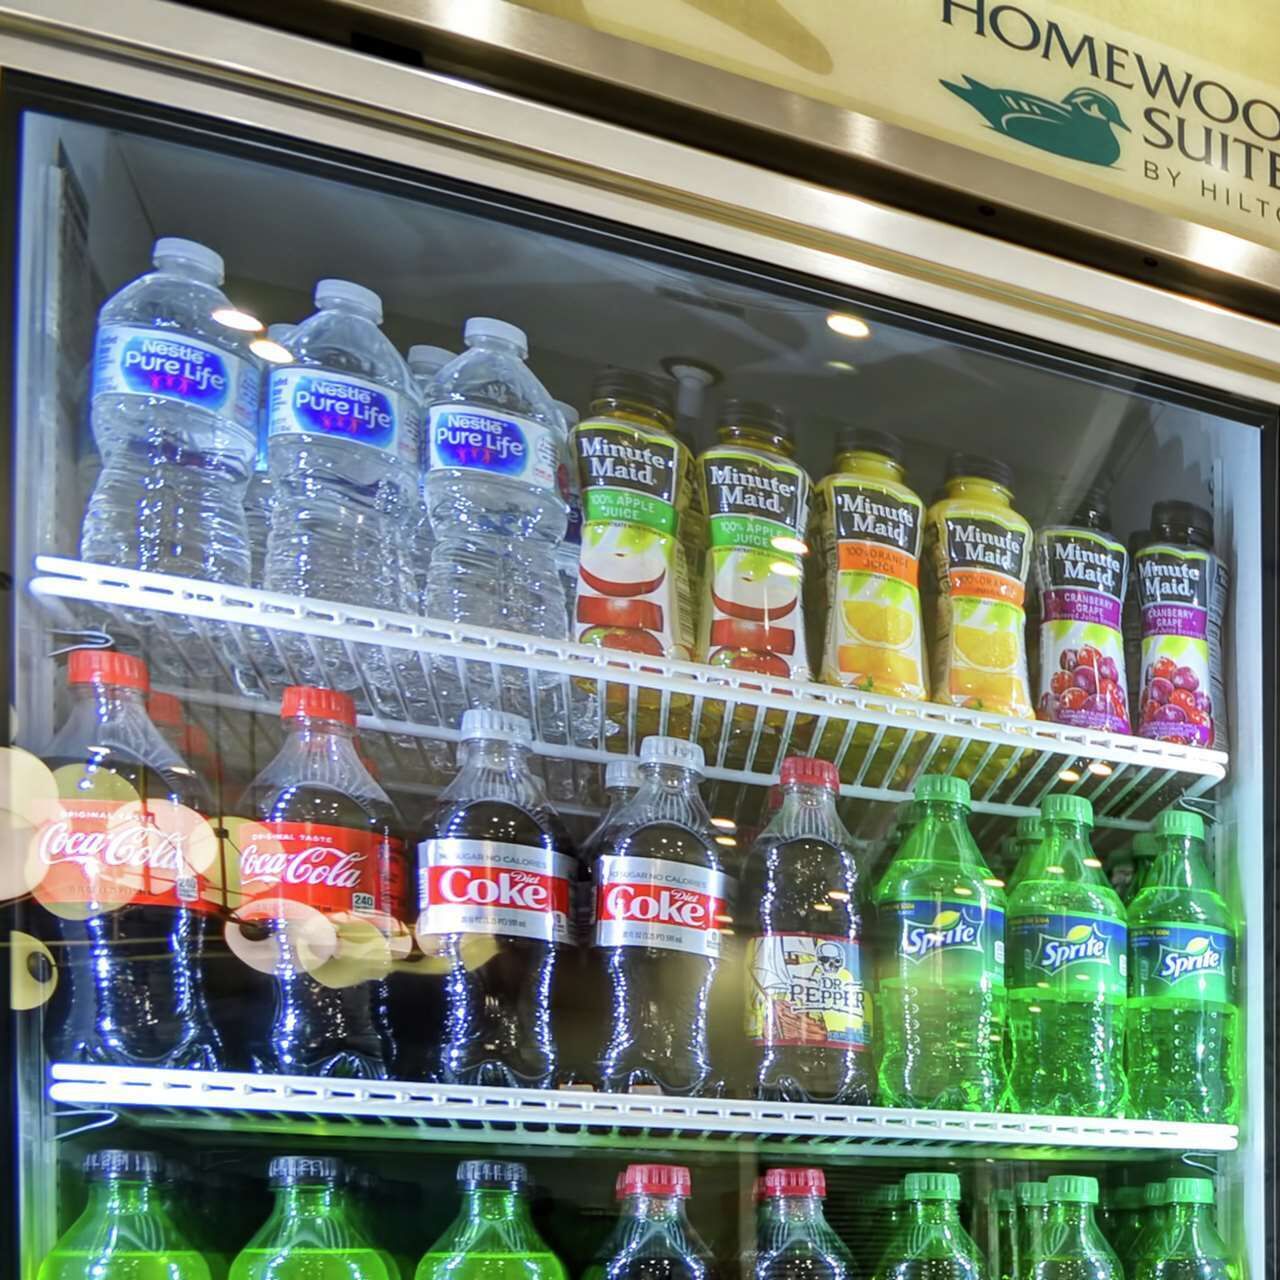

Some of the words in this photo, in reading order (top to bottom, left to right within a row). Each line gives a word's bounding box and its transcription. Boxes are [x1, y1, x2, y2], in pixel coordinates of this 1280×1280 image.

[1144, 160, 1181, 186] BY
[125, 351, 180, 374] Pure
[184, 360, 225, 390] Life
[296, 391, 349, 415] Pure
[353, 402, 392, 428] Life
[437, 427, 482, 447] Pure
[487, 436, 524, 459] Life
[580, 437, 665, 468] Minute
[591, 457, 655, 485] Maid
[710, 465, 792, 496] Minute
[617, 495, 655, 512] APPLE
[720, 486, 782, 513] Maid
[842, 494, 913, 526] Minute
[853, 514, 906, 542] Maid
[954, 525, 1020, 553] Minute
[965, 543, 1013, 570] Maid
[1055, 542, 1120, 573] Minute
[1064, 561, 1115, 588] Maid
[1139, 562, 1199, 581] Minute
[1146, 577, 1193, 596] Maid
[39, 821, 188, 871] Coca-Cola
[240, 845, 367, 888] Coca-Cola
[510, 870, 541, 884] Diet
[439, 868, 548, 909] Coke
[671, 889, 699, 902] Diet
[607, 885, 705, 926] Coke
[908, 924, 975, 955] Sprite
[1042, 937, 1105, 967] Sprite
[1161, 949, 1220, 977] Sprite
[790, 984, 865, 1008] PEPPER
[822, 976, 842, 990] DR
